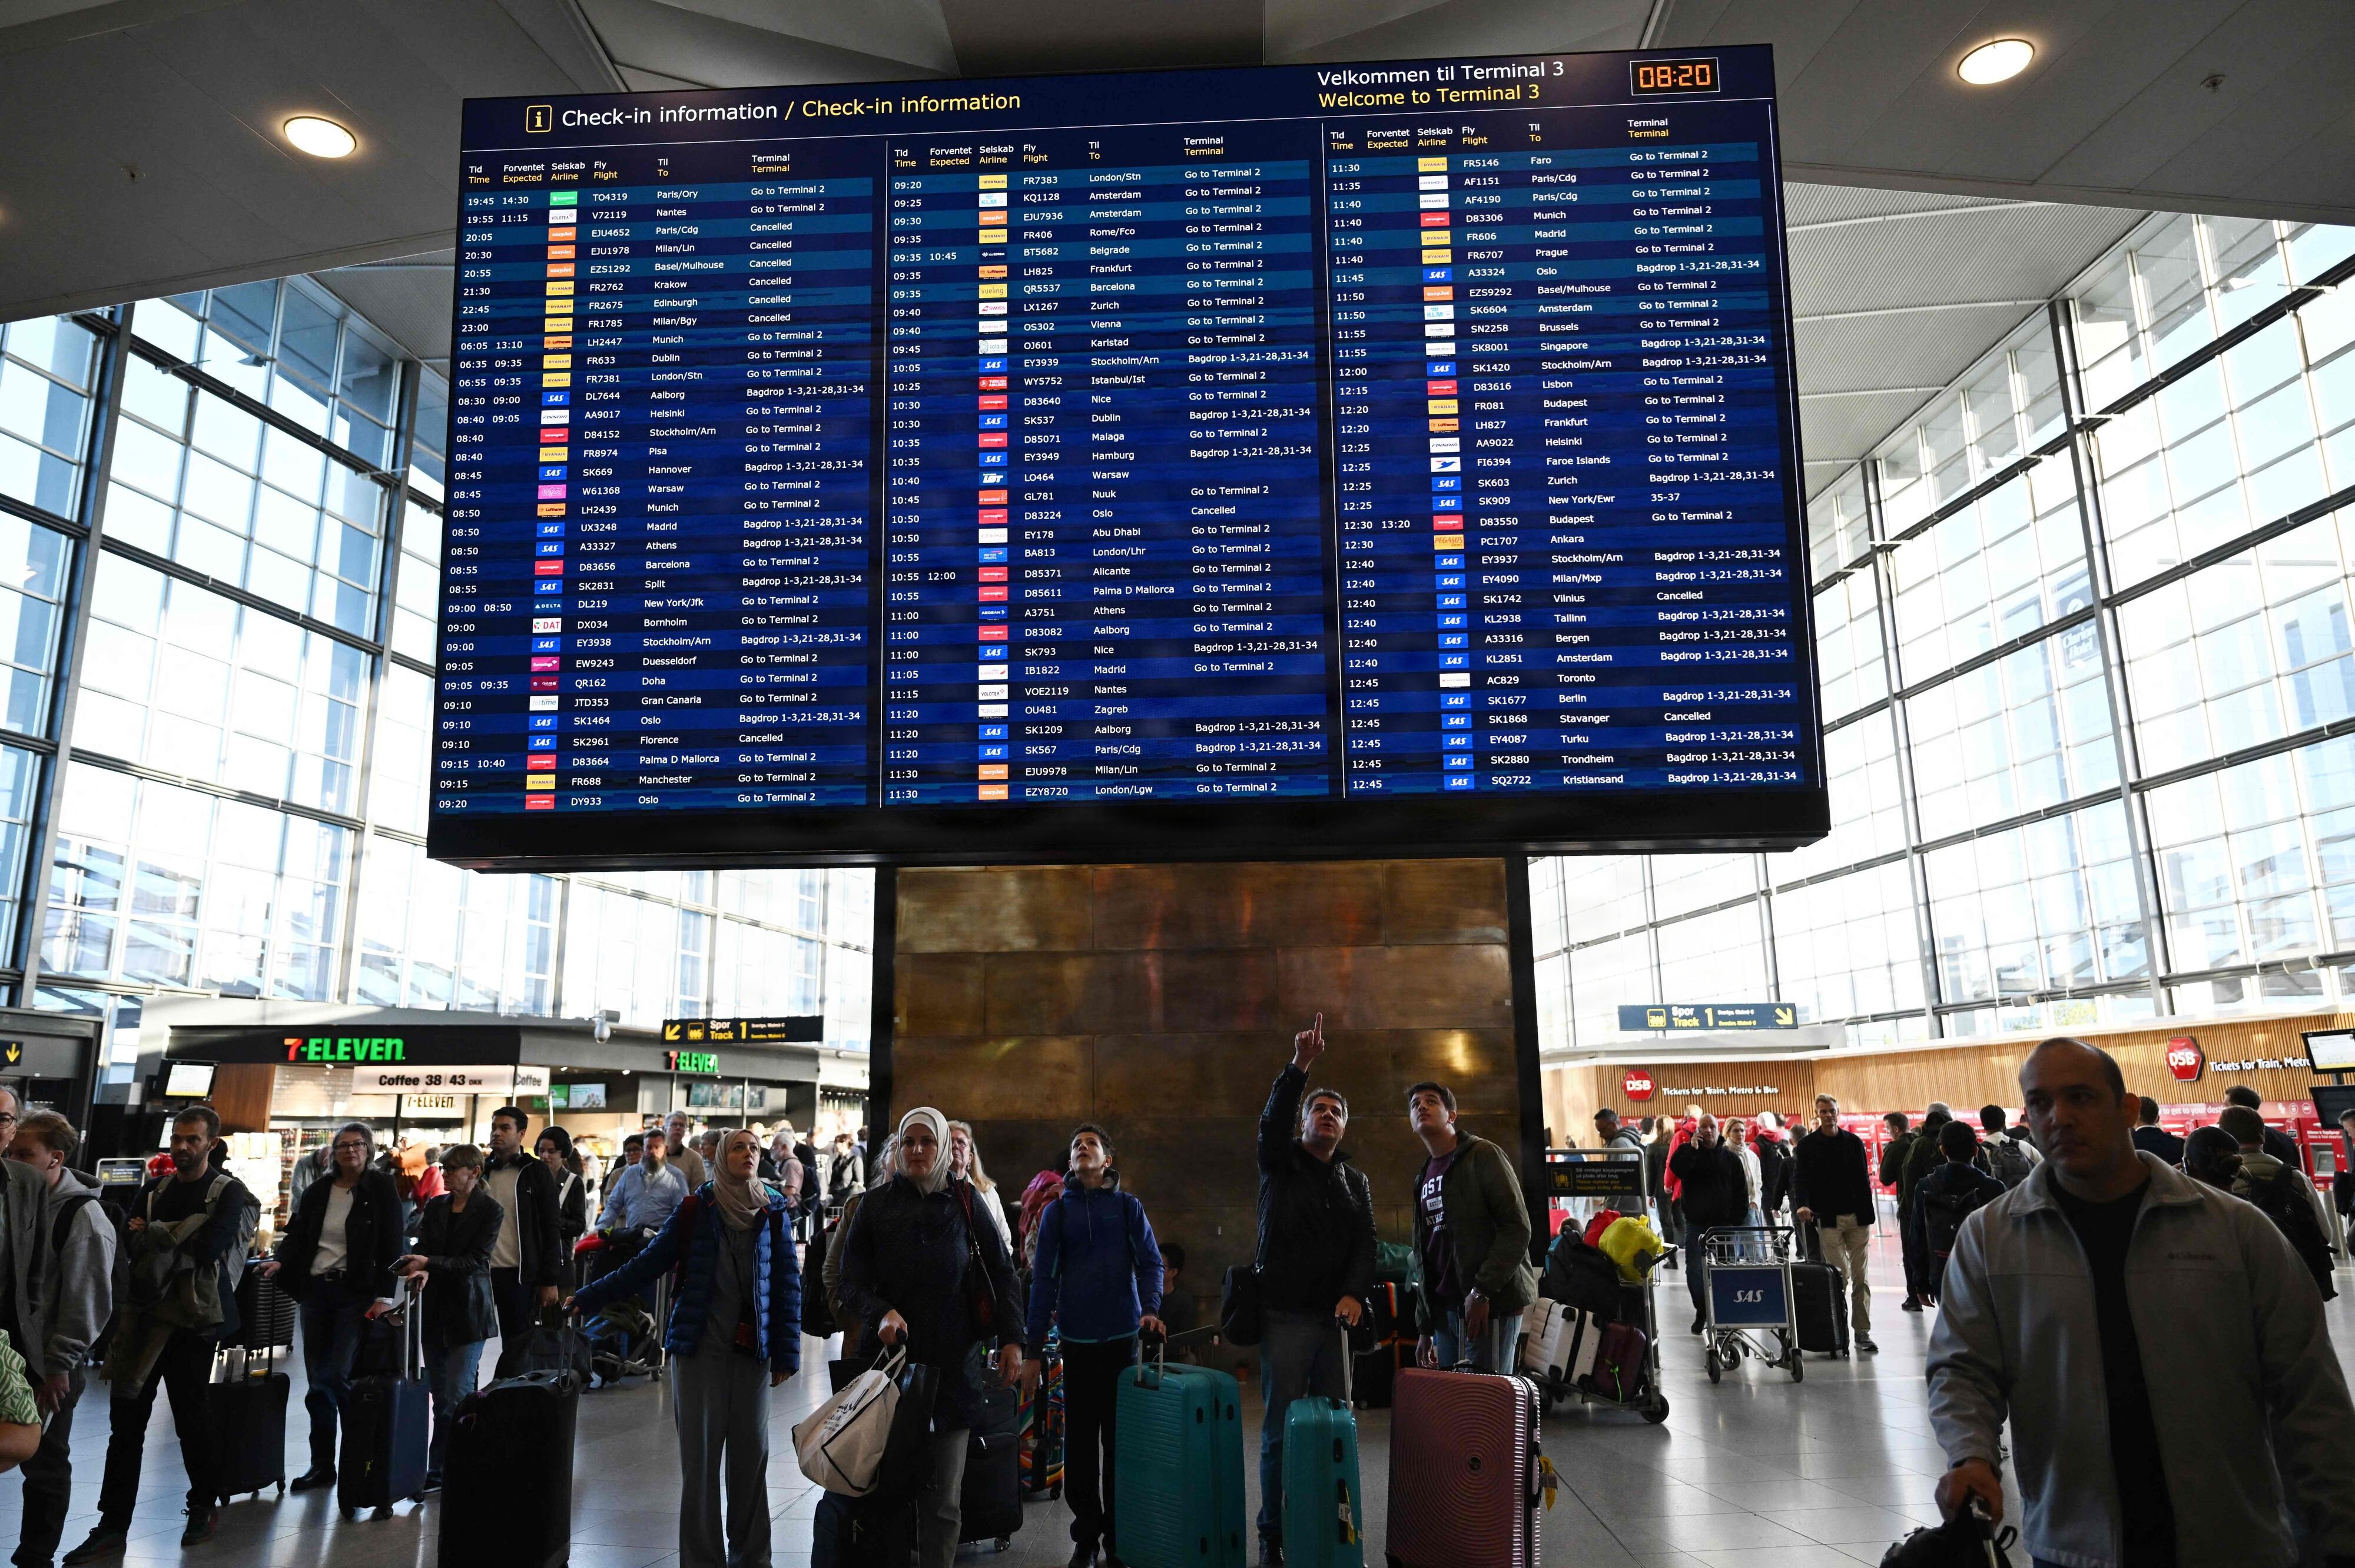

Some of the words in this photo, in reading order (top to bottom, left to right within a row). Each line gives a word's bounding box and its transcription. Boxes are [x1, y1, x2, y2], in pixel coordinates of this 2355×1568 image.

[1317, 69, 1429, 86] Velkommen
[1437, 65, 1454, 81] til
[1460, 61, 1545, 80] Terminal
[1553, 61, 1564, 77] 3
[1639, 65, 1710, 88] 08:20
[1318, 91, 1405, 108] Welcome
[1411, 89, 1430, 104] to
[1436, 84, 1520, 102] Terminal
[1528, 84, 1540, 99] 3
[562, 107, 651, 127] Check-in
[660, 103, 777, 122] information
[802, 98, 893, 117] Check-in
[902, 93, 1020, 113] information
[1330, 131, 1345, 139] Tid
[1367, 129, 1411, 138] Forventet
[1417, 127, 1453, 136] Selskab
[1462, 126, 1475, 135] Fly
[1528, 123, 1540, 131] Til
[1627, 118, 1668, 127] Terminal
[1367, 139, 1408, 150] Expected
[1418, 138, 1447, 147] Airline
[1462, 136, 1488, 146] Flight
[1627, 129, 1669, 138] Terminal
[469, 165, 482, 174] Tid
[503, 163, 545, 172] Forventet
[551, 161, 586, 170] Selskab
[594, 161, 607, 170] Fly
[657, 158, 668, 166] Til
[751, 153, 790, 162] Terminal
[503, 174, 542, 184] Expected
[550, 172, 579, 181] Airline
[593, 171, 618, 180] Flight
[751, 164, 790, 173] Terminal
[894, 181, 921, 190] 09:20
[1023, 176, 1058, 185] FR7383
[1089, 172, 1141, 182] London/Stn
[1212, 168, 1252, 177] Terminal
[1255, 168, 1261, 176] 2
[468, 197, 494, 206] 19:45
[503, 196, 529, 204] 14:30
[592, 192, 628, 201] TO4319
[657, 190, 698, 200] Paris/Ory
[777, 185, 816, 194] Terminal
[819, 185, 825, 193] 2
[464, 269, 491, 278] 20:55
[590, 264, 631, 274] EZS1292
[655, 261, 724, 271] Basel/Mulhouse
[749, 258, 792, 268] Cancelled
[1336, 274, 1364, 283] 11:45
[1428, 271, 1446, 279] SAS
[1468, 268, 1505, 277] A33324
[1536, 267, 1557, 275] Oslo
[1637, 263, 1676, 274] Bagdrop
[1679, 260, 1760, 271] 1-3,21-28,31-34
[458, 397, 485, 406] 08:30
[493, 396, 520, 404] 09:00
[586, 391, 621, 400] DL7644
[650, 391, 685, 400] Aalborg
[747, 388, 784, 398] Bagdrop
[788, 385, 864, 396] 1-3,21-28,31-34
[1344, 501, 1372, 510] 12:25
[1479, 496, 1511, 506] SK909
[1548, 496, 1569, 504] New
[1571, 494, 1616, 504] York/Ewr
[1651, 493, 1680, 501] 35-37
[1345, 540, 1374, 549] 12:30
[1481, 536, 1518, 546] PC1707
[1550, 534, 1584, 543] Ankara
[448, 604, 476, 613] 09:00
[484, 603, 512, 612] 08:50
[578, 600, 608, 609] DL219
[644, 599, 664, 607] New
[666, 597, 704, 608] York/Jfk
[742, 597, 755, 605] Go
[757, 597, 767, 605] to
[769, 595, 810, 604] Terminal
[812, 595, 818, 603] 2
[890, 710, 918, 719] 11:20
[1025, 706, 1057, 715] OU481
[1094, 705, 1128, 715] Zagreb
[1353, 780, 1382, 789] 12:45
[1450, 778, 1468, 786] SAS
[1491, 775, 1531, 786] SQ2722
[1563, 774, 1624, 785] Kristiansand
[1668, 773, 1710, 784] Bagdrop
[1713, 771, 1797, 783] 1-3,21-28,31-34
[1671, 1006, 1694, 1017] Spor
[1705, 1008, 1713, 1026] 1
[1672, 1017, 1699, 1026] Track
[710, 1021, 731, 1030] Spor
[739, 1021, 747, 1039] 1
[710, 1031, 734, 1040] Track
[2168, 1052, 2195, 1066] DSB
[2209, 1061, 2240, 1072] Tickets
[2242, 1059, 2256, 1070] for
[2257, 1059, 2282, 1069] Train,
[379, 1075, 419, 1087] Coffee
[425, 1075, 442, 1086] 38
[449, 1075, 466, 1086] 43
[1626, 1080, 1651, 1091] DSB
[1662, 1087, 1690, 1095] Tickets
[1705, 1087, 1727, 1095] Train,
[1729, 1087, 1753, 1095] Metro
[1763, 1086, 1779, 1094] Bus
[1733, 1290, 1764, 1303] SAS
